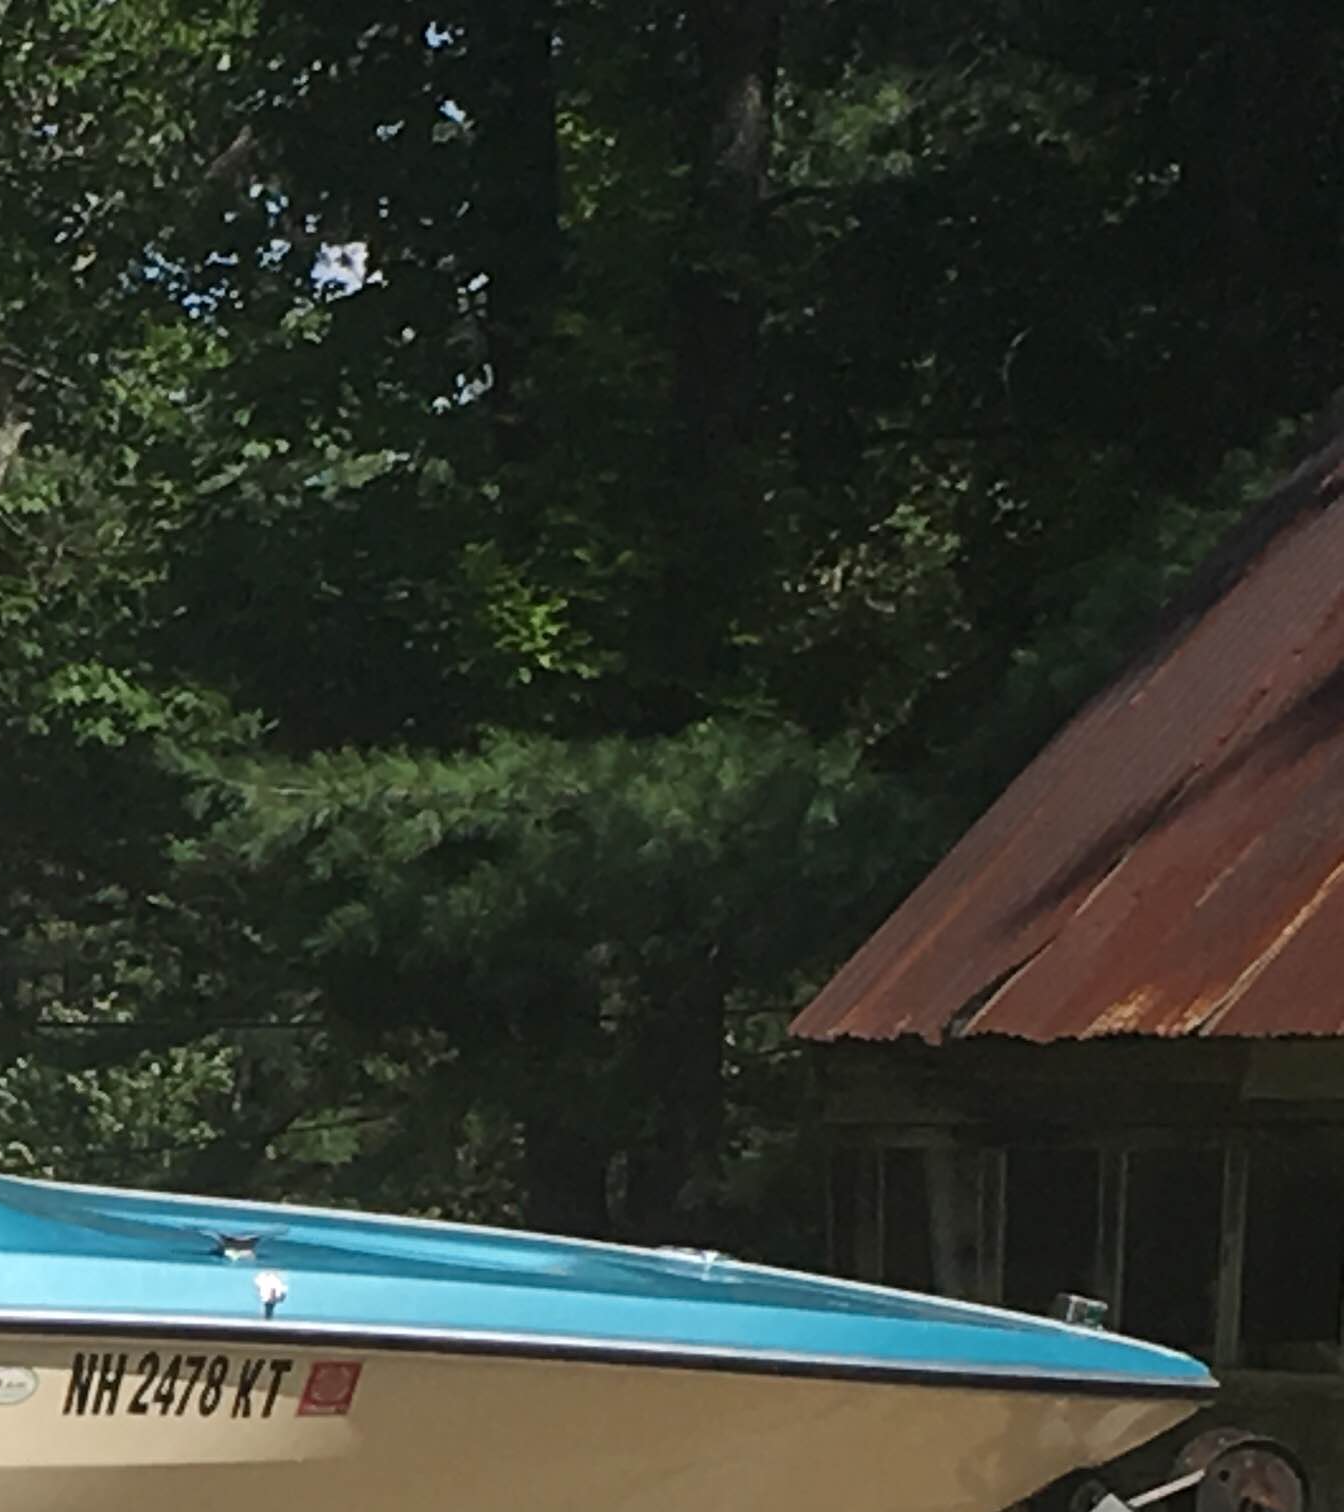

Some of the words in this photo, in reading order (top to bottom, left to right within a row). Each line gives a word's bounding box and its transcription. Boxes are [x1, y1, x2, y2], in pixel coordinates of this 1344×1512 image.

[63, 1352, 127, 1416] NH
[127, 1351, 229, 1417] 2478
[231, 1357, 293, 1419] KT
